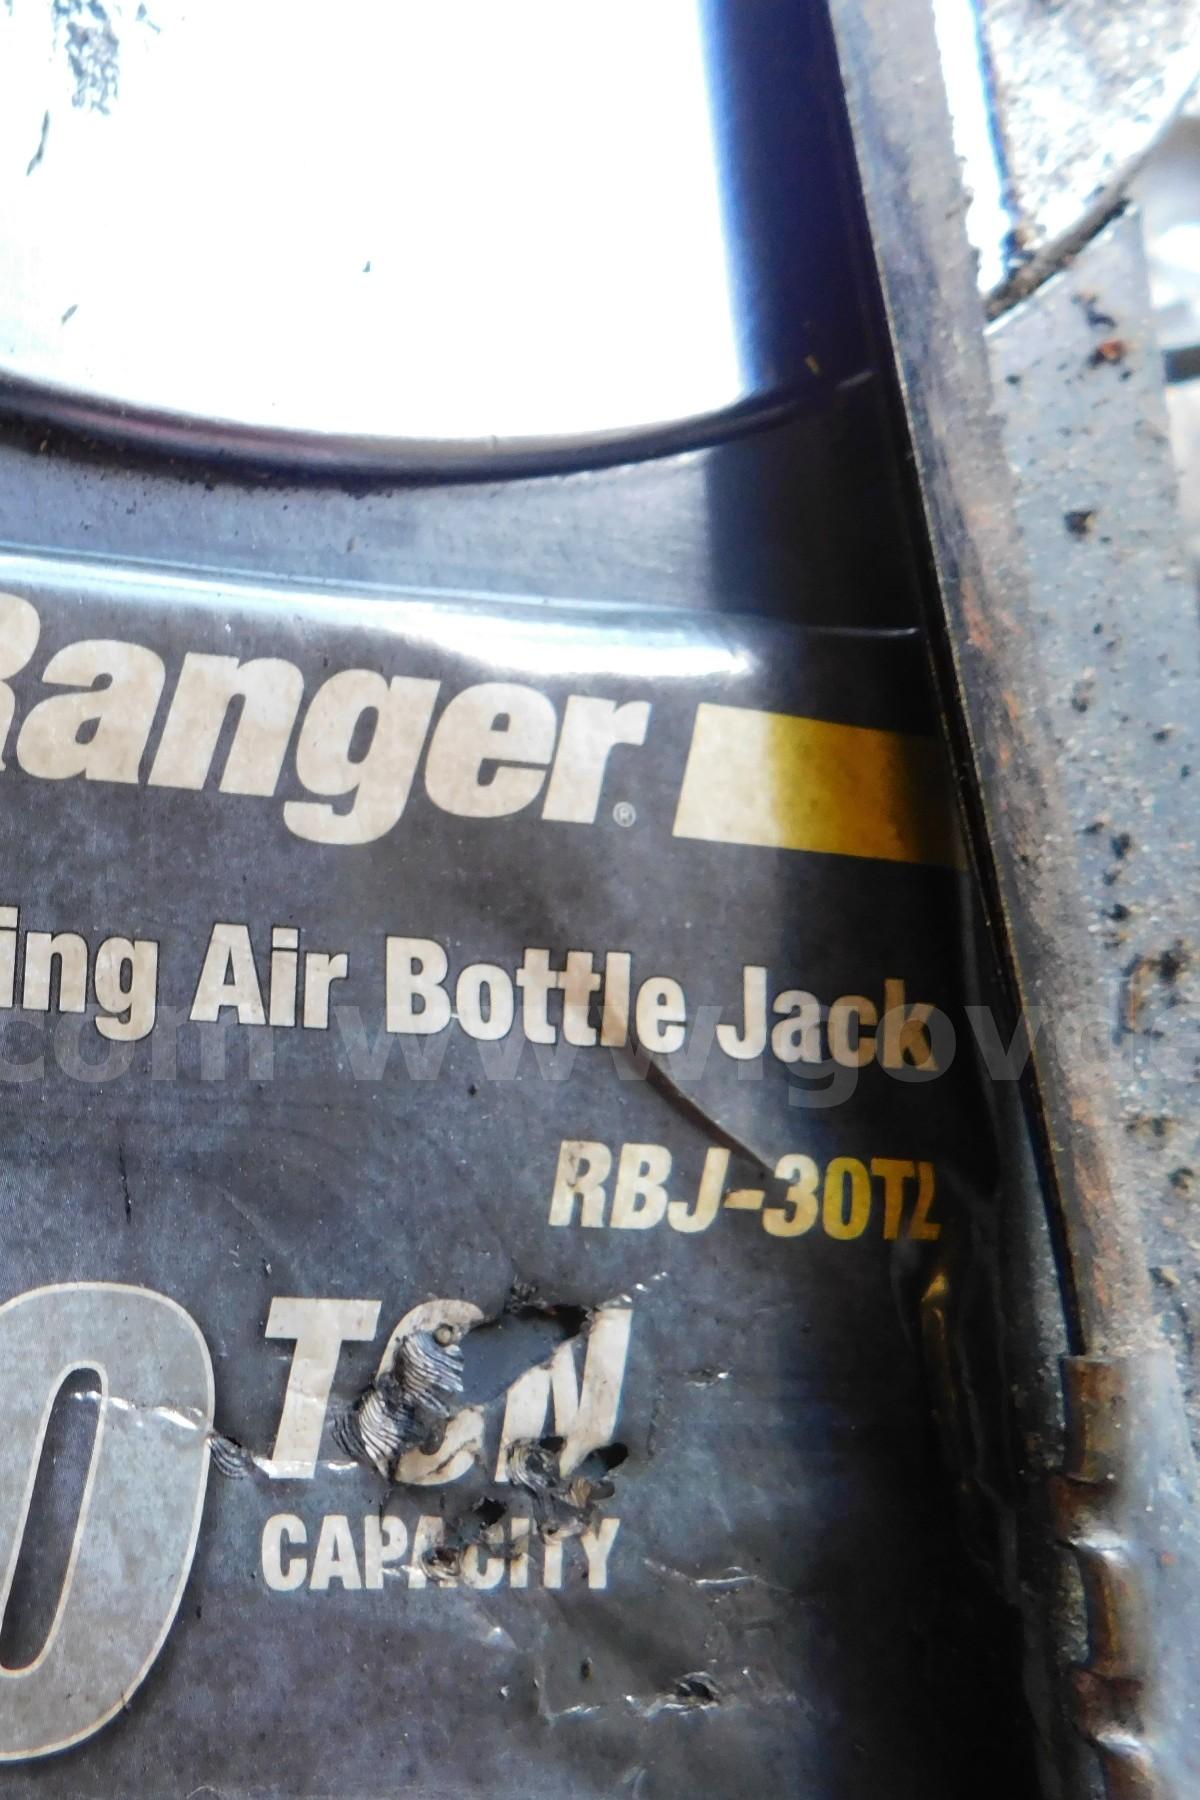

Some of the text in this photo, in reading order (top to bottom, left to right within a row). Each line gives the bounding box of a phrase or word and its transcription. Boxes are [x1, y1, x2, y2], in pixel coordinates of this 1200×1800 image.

[189, 922, 348, 1030] Air
[385, 935, 686, 1054] Bottle
[715, 965, 939, 1073] Jack
